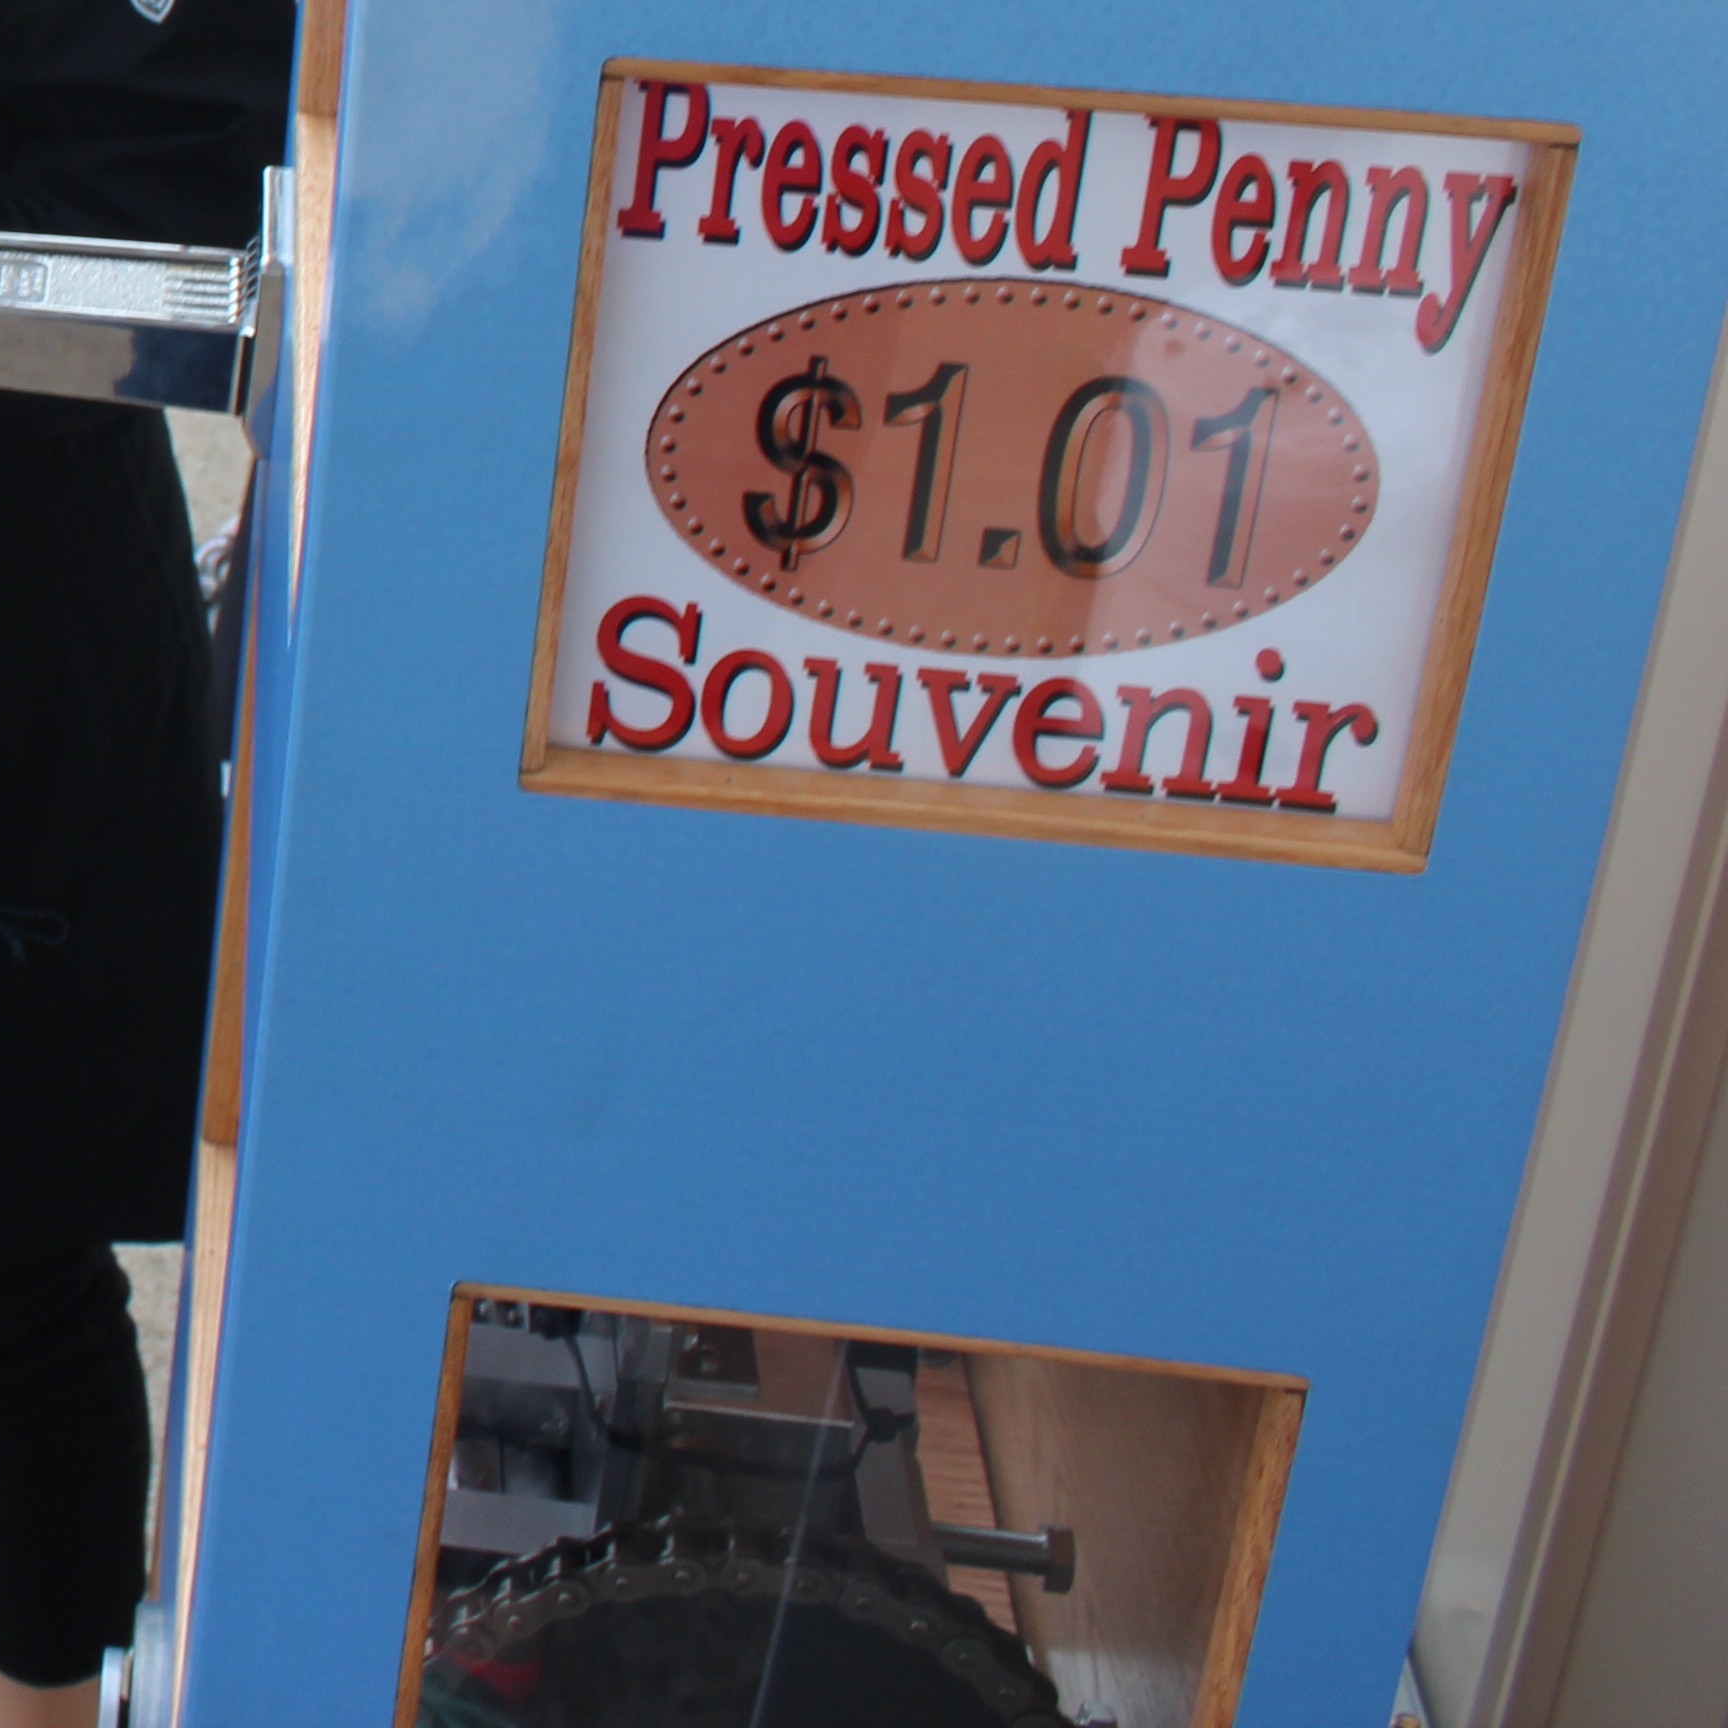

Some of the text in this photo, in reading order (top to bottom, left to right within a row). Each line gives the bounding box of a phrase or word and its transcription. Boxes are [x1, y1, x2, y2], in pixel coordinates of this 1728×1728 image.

[617, 77, 1518, 353] Pressed Penny
[741, 355, 1282, 591] $1.01
[585, 594, 1379, 813] Souvenir
